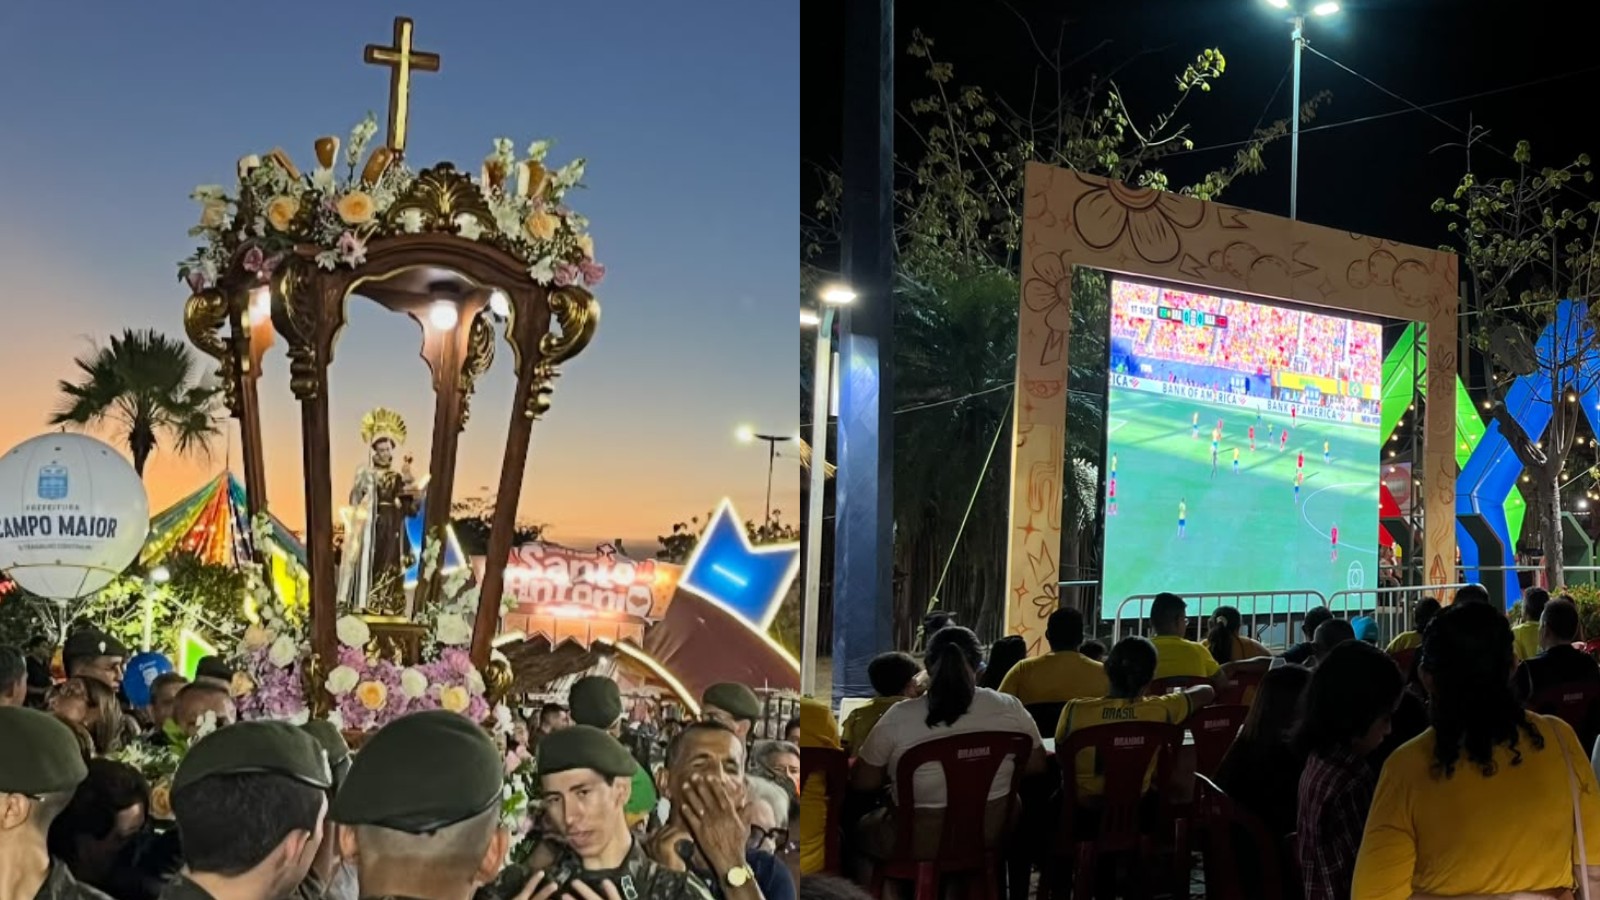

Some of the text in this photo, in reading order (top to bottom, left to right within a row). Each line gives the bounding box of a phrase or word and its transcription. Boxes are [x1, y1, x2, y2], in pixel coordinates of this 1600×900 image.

[1163, 382, 1237, 404] BANK OF AMRICA
[1267, 400, 1289, 412] BANK
[1302, 406, 1337, 419] AMERICA
[58, 515, 118, 538] MAIOR
[519, 544, 637, 590] Santo
[1102, 707, 1138, 719] BRASIL
